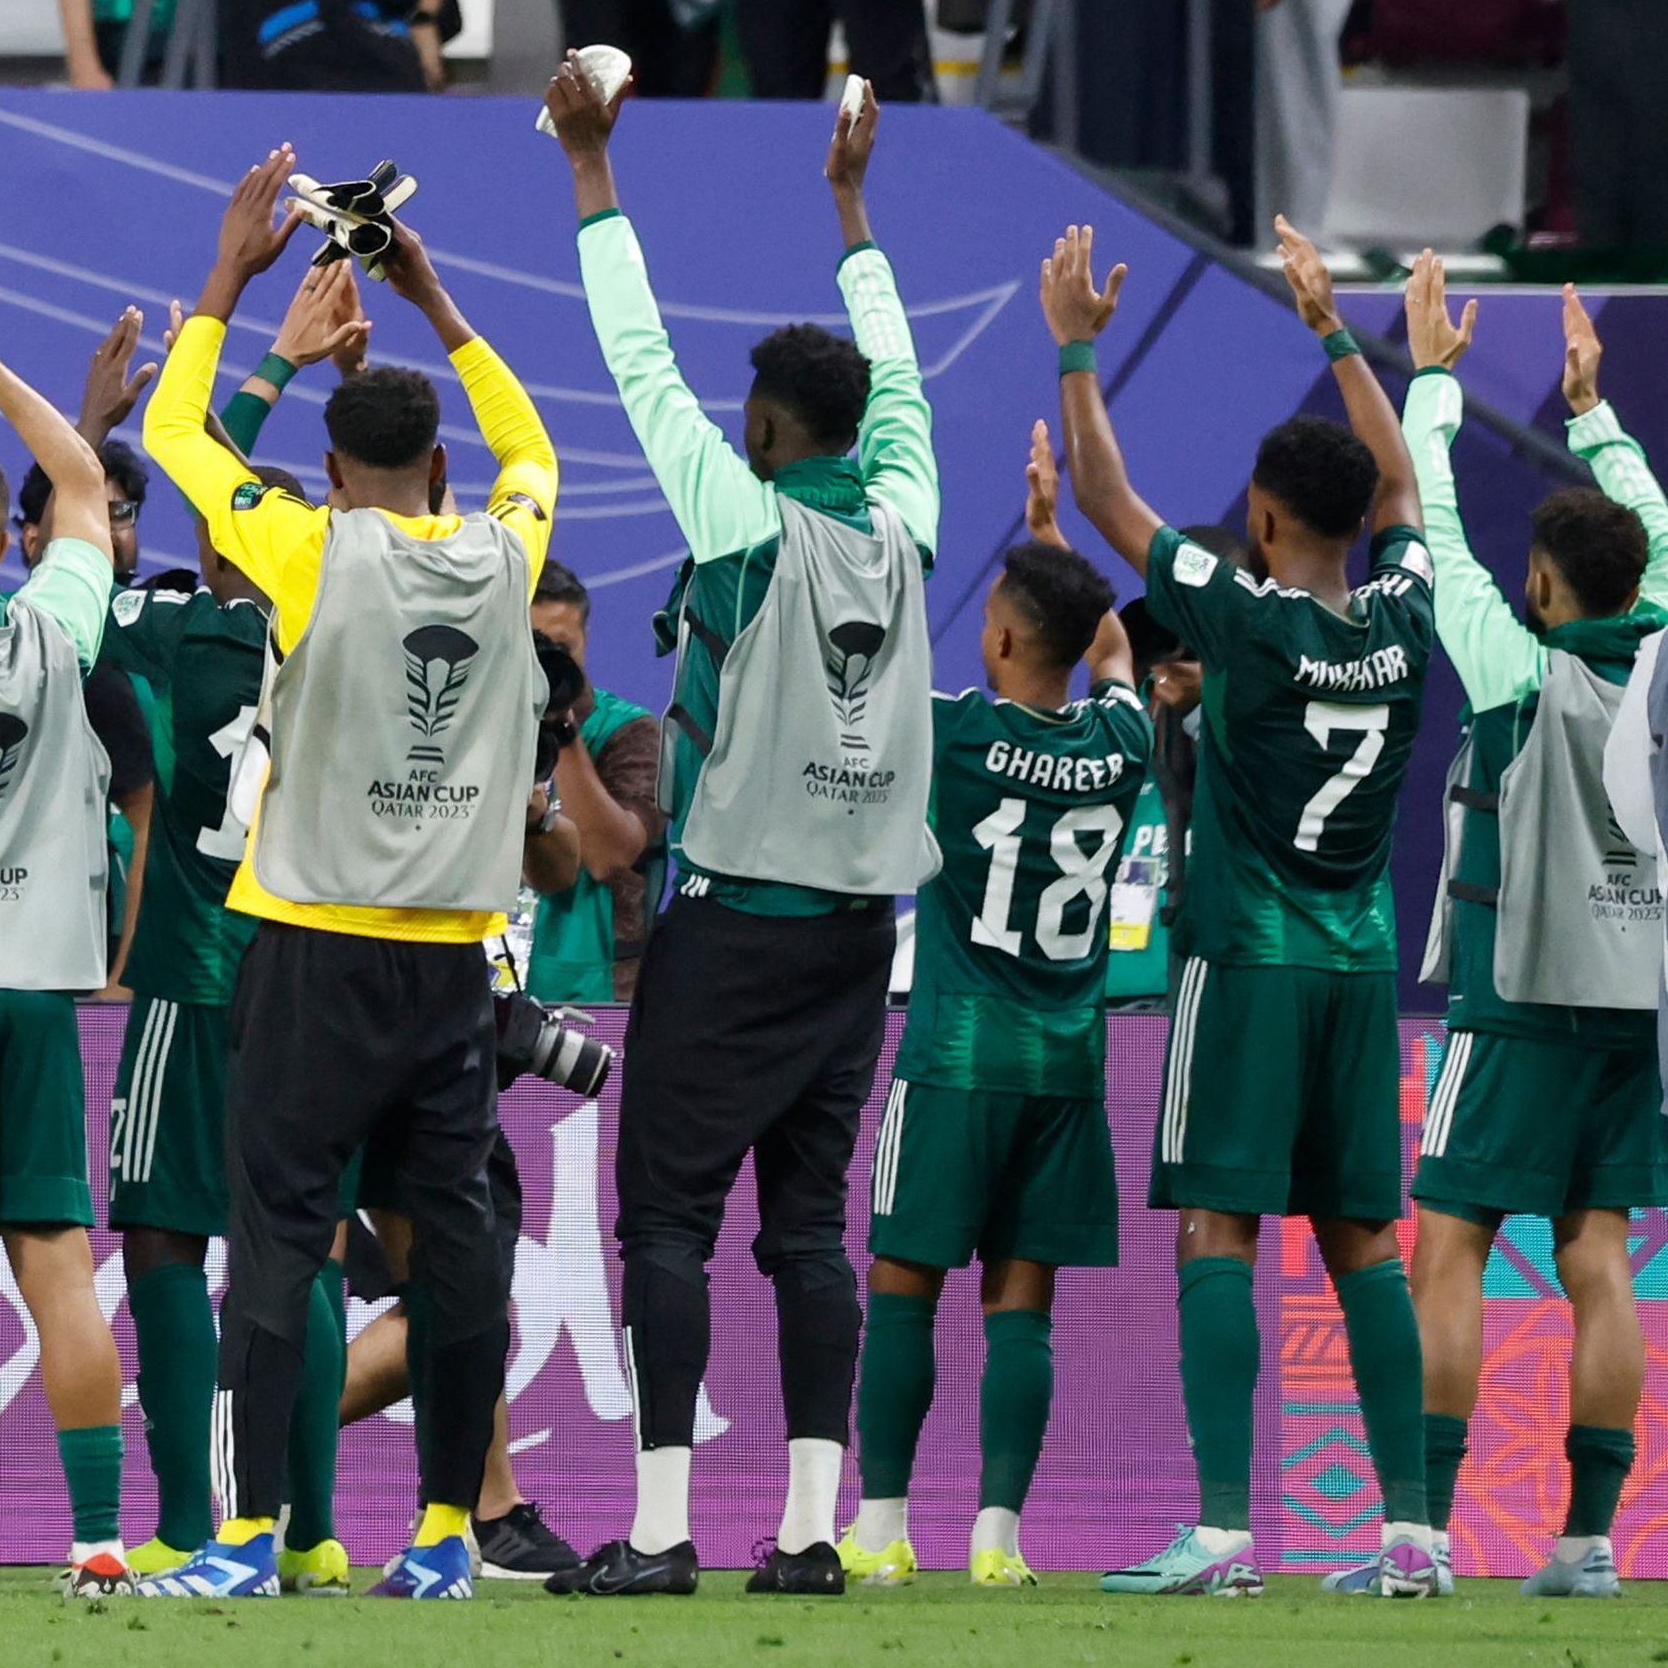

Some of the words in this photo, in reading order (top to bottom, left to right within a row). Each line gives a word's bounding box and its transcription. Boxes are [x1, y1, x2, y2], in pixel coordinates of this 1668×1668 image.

[843, 756, 870, 769] AFC
[409, 769, 438, 783] AFC
[803, 761, 867, 787] ASIAN
[1293, 700, 1390, 852] 7
[367, 780, 430, 802] ASIAN
[433, 785, 480, 802] CUP
[806, 781, 859, 804] QATAR
[372, 799, 424, 819] QATAR
[428, 805, 471, 819] 2023
[970, 797, 1124, 961] 18
